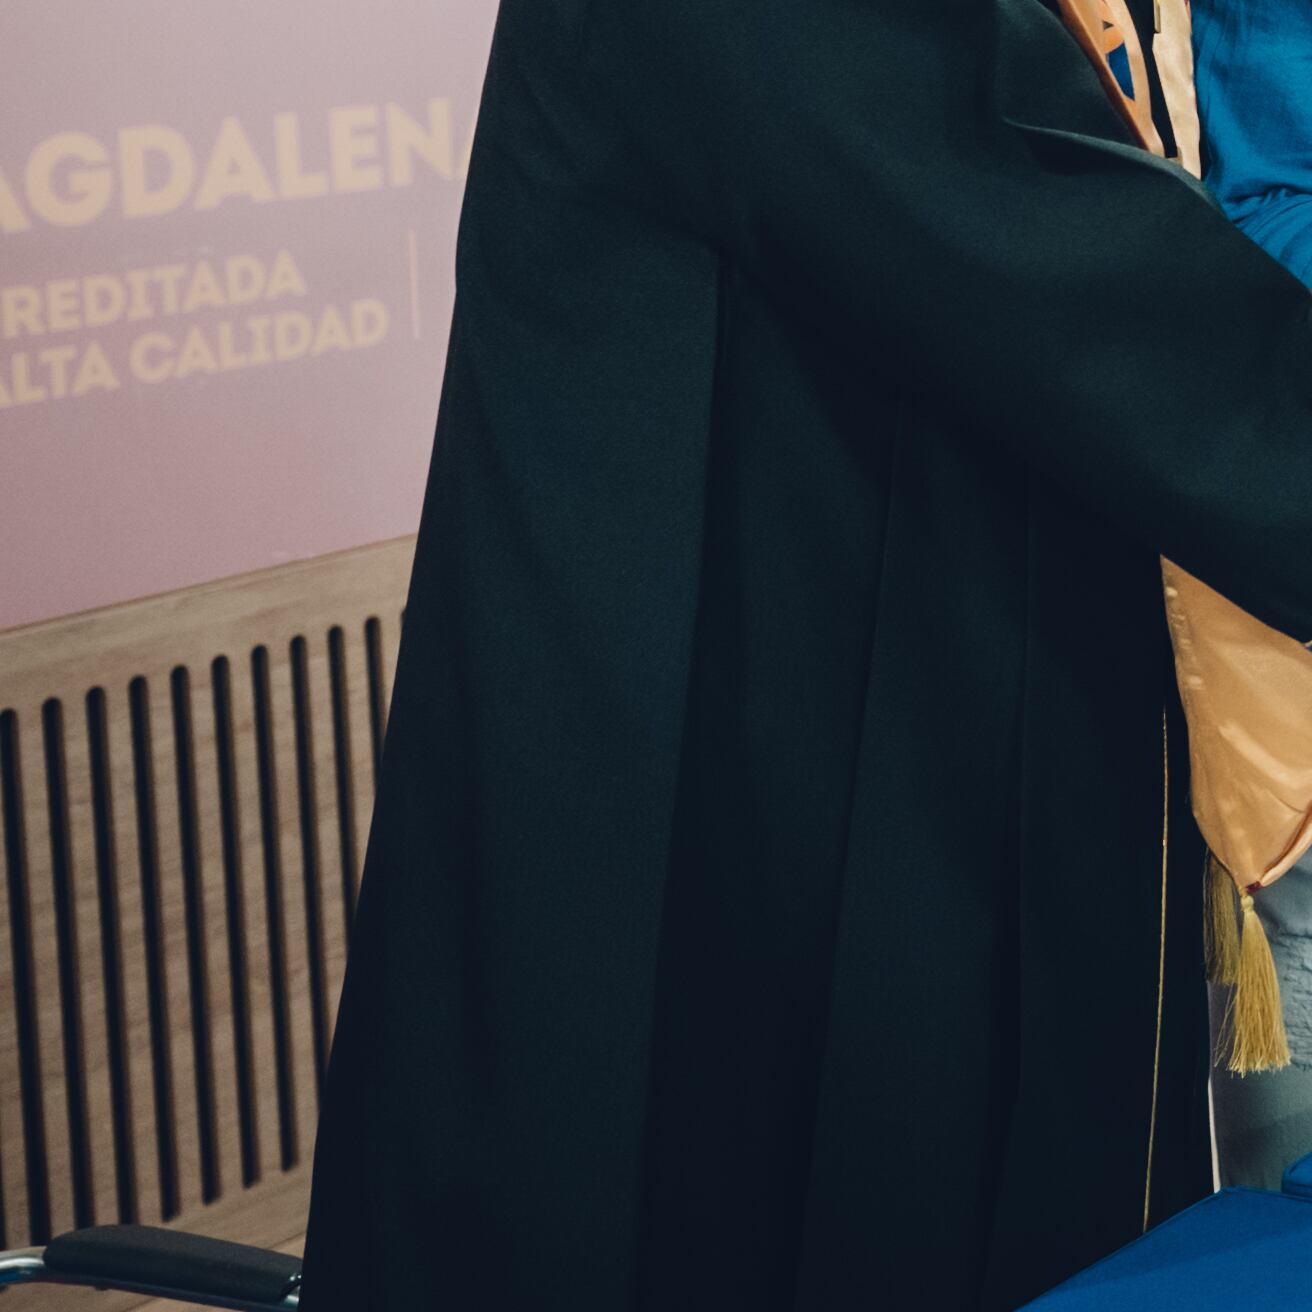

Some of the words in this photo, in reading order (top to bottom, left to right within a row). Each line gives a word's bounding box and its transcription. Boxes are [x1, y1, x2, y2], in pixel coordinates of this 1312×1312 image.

[0, 96, 475, 234] GDALEN
[2, 249, 309, 340] REDITADA
[130, 298, 390, 385] CALIDAD
